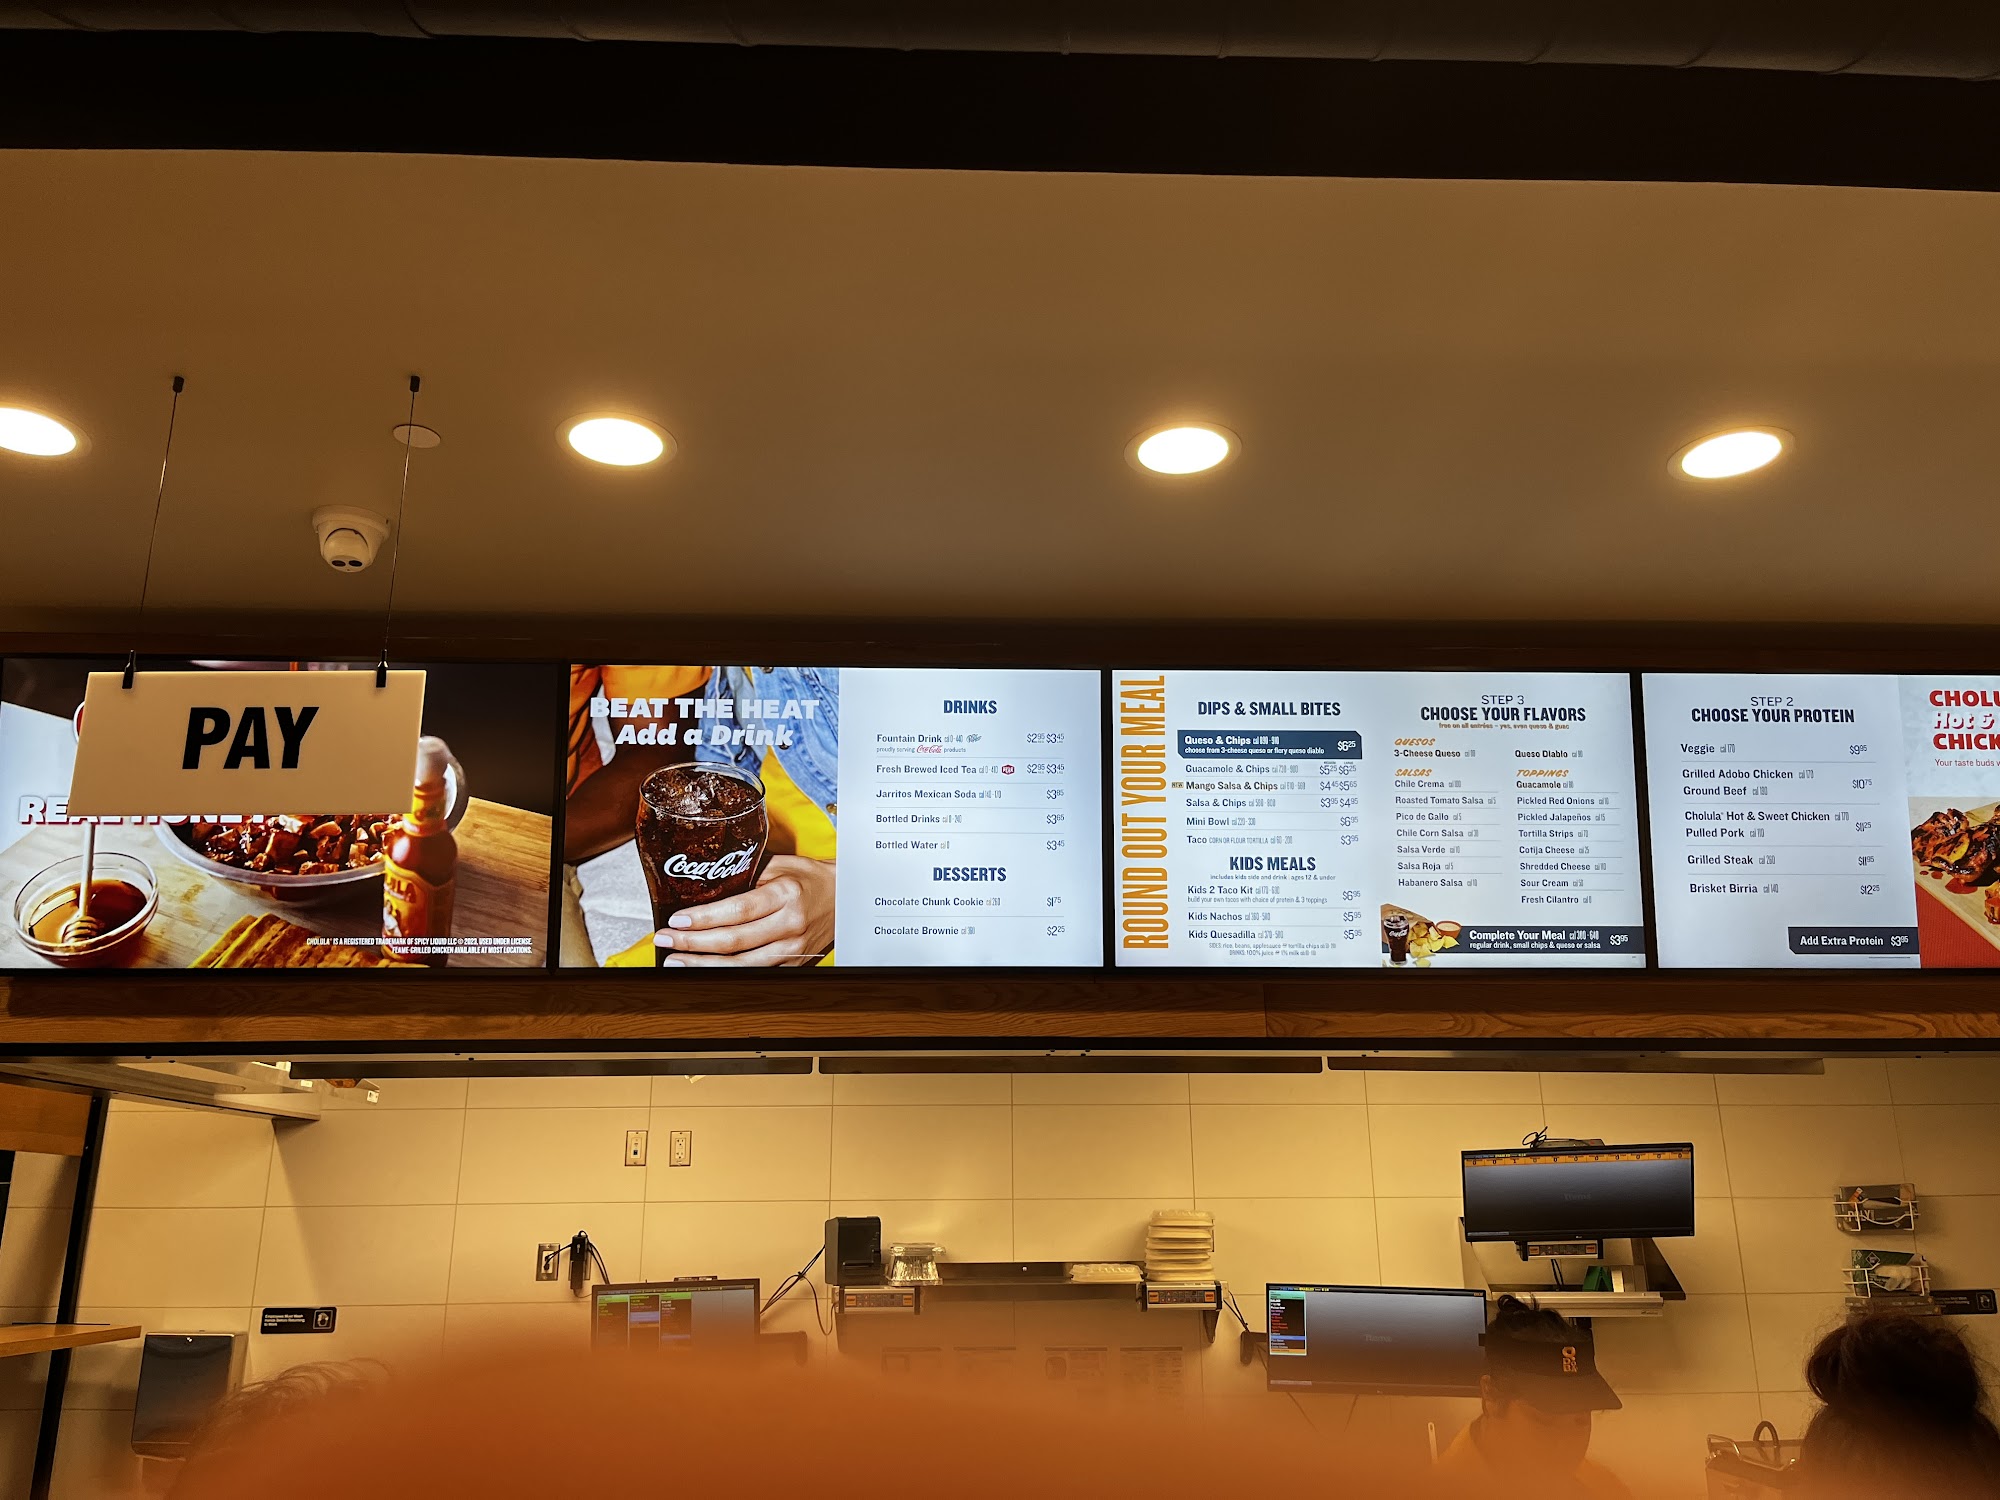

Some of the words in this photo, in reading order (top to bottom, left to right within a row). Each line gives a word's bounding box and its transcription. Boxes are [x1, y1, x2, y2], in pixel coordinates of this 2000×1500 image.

[1481, 694, 1514, 705] STEP
[1517, 695, 1525, 705] 3
[1750, 696, 1783, 707] STEP
[1786, 696, 1794, 707] 2
[590, 697, 668, 718] BEAT
[675, 699, 733, 719] THE
[741, 699, 819, 719] HEAT
[943, 700, 998, 714] DRINKS
[1120, 675, 1165, 735] MEAL
[1198, 701, 1231, 716] DIPS
[1234, 701, 1247, 716] &
[1249, 701, 1298, 716] SMALL
[1300, 702, 1341, 716] BITES
[1420, 706, 1478, 721] CHOOSE
[1481, 707, 1520, 721] YOUR
[1523, 707, 1586, 722] FLAVORS
[1691, 708, 1749, 723] CHOOSE
[1751, 708, 1791, 723] YOUR
[1793, 709, 1855, 723] PROTEIN
[181, 705, 319, 770] PAY
[616, 723, 677, 745] Add
[683, 728, 702, 745] a
[711, 725, 793, 746] Drink
[877, 734, 915, 743] Fountain
[918, 734, 942, 743] Drink
[1184, 735, 1214, 745] Queso
[1215, 735, 1224, 745] &
[1225, 735, 1251, 747] Chips
[1394, 738, 1436, 746] QUESOS
[1394, 749, 1433, 758] 3-Cheese
[1434, 749, 1461, 758] Queso
[1514, 749, 1541, 758] Queso
[1542, 750, 1568, 758] Diablo
[1680, 743, 1715, 755] Veggie
[1934, 758, 1953, 767] Your
[1954, 759, 1974, 767] taste
[1975, 758, 1995, 767] buds
[876, 764, 902, 773] Fresh
[904, 765, 938, 774] Brewed
[940, 765, 959, 774] Iced
[960, 765, 977, 774] Tea
[1185, 764, 1234, 773] Guacamole
[1235, 764, 1244, 773] &
[1245, 764, 1270, 775] Chips
[1394, 768, 1433, 777] SALSAS
[1516, 769, 1569, 778] TOPPINGS
[1682, 769, 1715, 779] Grilled
[1718, 769, 1750, 779] Adobo
[1753, 769, 1793, 779] Chicken
[1121, 745, 1166, 806] YOUR
[1186, 781, 1216, 792] Mango
[1217, 781, 1242, 790] Salsa
[1243, 781, 1252, 790] &
[1253, 781, 1278, 792] Chips
[1394, 779, 1416, 788] Chile
[1417, 779, 1445, 788] Crema
[1516, 780, 1561, 789] Guacamole
[875, 789, 912, 798] Jarritos
[914, 789, 952, 798] Mexican
[954, 789, 977, 799] Soda
[1683, 785, 1721, 796] Ground
[1723, 786, 1747, 796] Beef
[1186, 798, 1210, 807] Salsa
[1212, 798, 1220, 807] &
[1222, 798, 1247, 809] Chips
[1395, 796, 1428, 804] Roasted
[1429, 796, 1460, 804] Tomato
[1461, 796, 1484, 805] Salsa
[1517, 796, 1547, 805] Pickled
[1548, 796, 1565, 805] Red
[1566, 796, 1595, 805] Onions
[876, 814, 909, 823] Bottled
[911, 814, 940, 823] Drinks
[1396, 812, 1414, 821] Pico
[1416, 812, 1426, 821] de
[1428, 812, 1449, 821] Gallo
[1517, 813, 1548, 821] Pickled
[1549, 813, 1591, 823] Jalapeños
[1726, 811, 1745, 821] Hot
[1746, 811, 1756, 821] &
[1757, 811, 1789, 821] Sweet
[1791, 811, 1830, 821] Chicken
[1186, 817, 1206, 826] Mini
[1208, 817, 1230, 826] Bowl
[1122, 813, 1167, 858] OUT
[1396, 828, 1418, 837] Chile
[1419, 828, 1439, 837] Corn
[1441, 828, 1464, 837] Salsa
[1518, 829, 1548, 838] Tortilla
[1549, 829, 1574, 839] Strips
[1686, 828, 1718, 838] Pulled
[1720, 828, 1745, 838] Pork
[875, 840, 908, 849] Bottled
[910, 840, 938, 849] Water
[1186, 835, 1207, 844] Taco
[1397, 845, 1420, 854] Salsa
[1421, 845, 1446, 854] Verde
[1519, 845, 1543, 856] Cotija
[1545, 845, 1575, 854] Cheese
[663, 843, 758, 881] Coca-Cola
[1229, 856, 1264, 871] KIDS
[1267, 856, 1316, 871] MEALS
[1687, 854, 1721, 865] Grilled
[1723, 854, 1754, 865] Steak
[1397, 862, 1420, 870] Salsa
[1422, 862, 1441, 872] Roja
[1519, 862, 1559, 871] Shredded
[1560, 862, 1591, 871] Cheese
[933, 866, 1007, 882] DESSERTS
[1398, 878, 1439, 887] Habanero
[1440, 878, 1463, 887] Salsa
[1520, 878, 1540, 887] Sour
[1542, 878, 1569, 887] Cream
[1187, 885, 1207, 894] Kids
[1209, 885, 1215, 894] 2
[1217, 885, 1238, 894] Taco
[1240, 885, 1253, 894] Kit
[1689, 883, 1726, 893] Brisket
[1729, 883, 1758, 893] Birria
[874, 897, 920, 906] Chocolate
[922, 897, 951, 906] Chunk
[953, 897, 984, 906] Cookie
[1521, 895, 1544, 904] Fresh
[1546, 895, 1579, 904] Cilantro
[1122, 867, 1169, 948] ROUND
[1188, 911, 1208, 921] Kids
[1210, 912, 1243, 921] Nachos
[874, 926, 919, 935] Chocolate
[922, 926, 959, 935] Brownie
[1188, 930, 1208, 939] Kids
[1210, 930, 1256, 939] Quesadilla
[1469, 929, 1515, 943] Complete
[1516, 929, 1540, 943] Your
[1541, 929, 1566, 943] Meal
[1800, 935, 1819, 946] Add
[1821, 935, 1848, 946] Extra
[1849, 936, 1884, 946] Protein
[1469, 940, 1493, 951] regular
[1493, 940, 1512, 950] drink,
[1512, 941, 1530, 949] small
[1530, 940, 1548, 950] chips
[1548, 940, 1556, 949] &
[1555, 942, 1576, 951] queso
[1584, 941, 1601, 949] salsa
